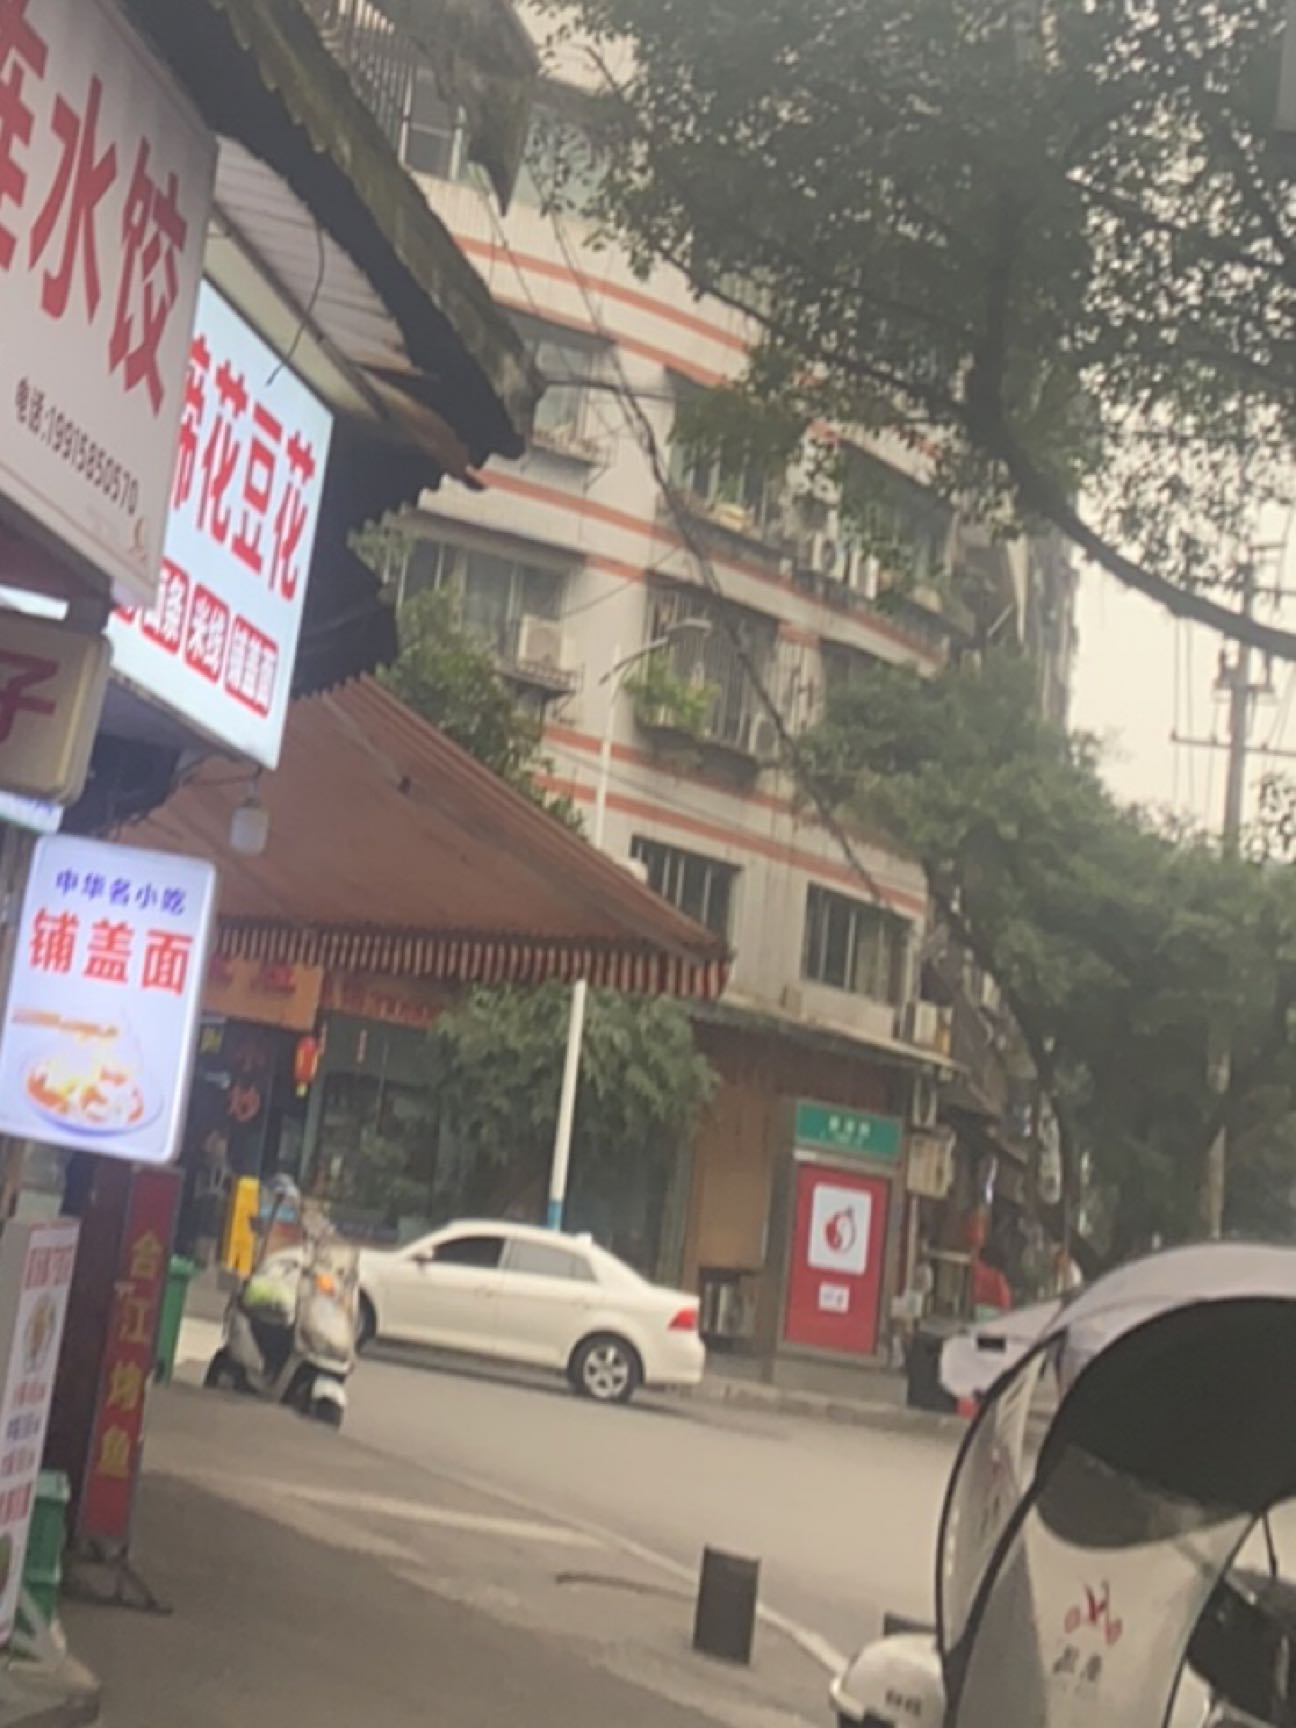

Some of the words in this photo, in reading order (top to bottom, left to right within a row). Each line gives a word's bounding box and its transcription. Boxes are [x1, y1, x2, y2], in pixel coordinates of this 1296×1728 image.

[56, 869, 185, 915] 中华名小吃
[28, 905, 193, 996] 铺盖面
